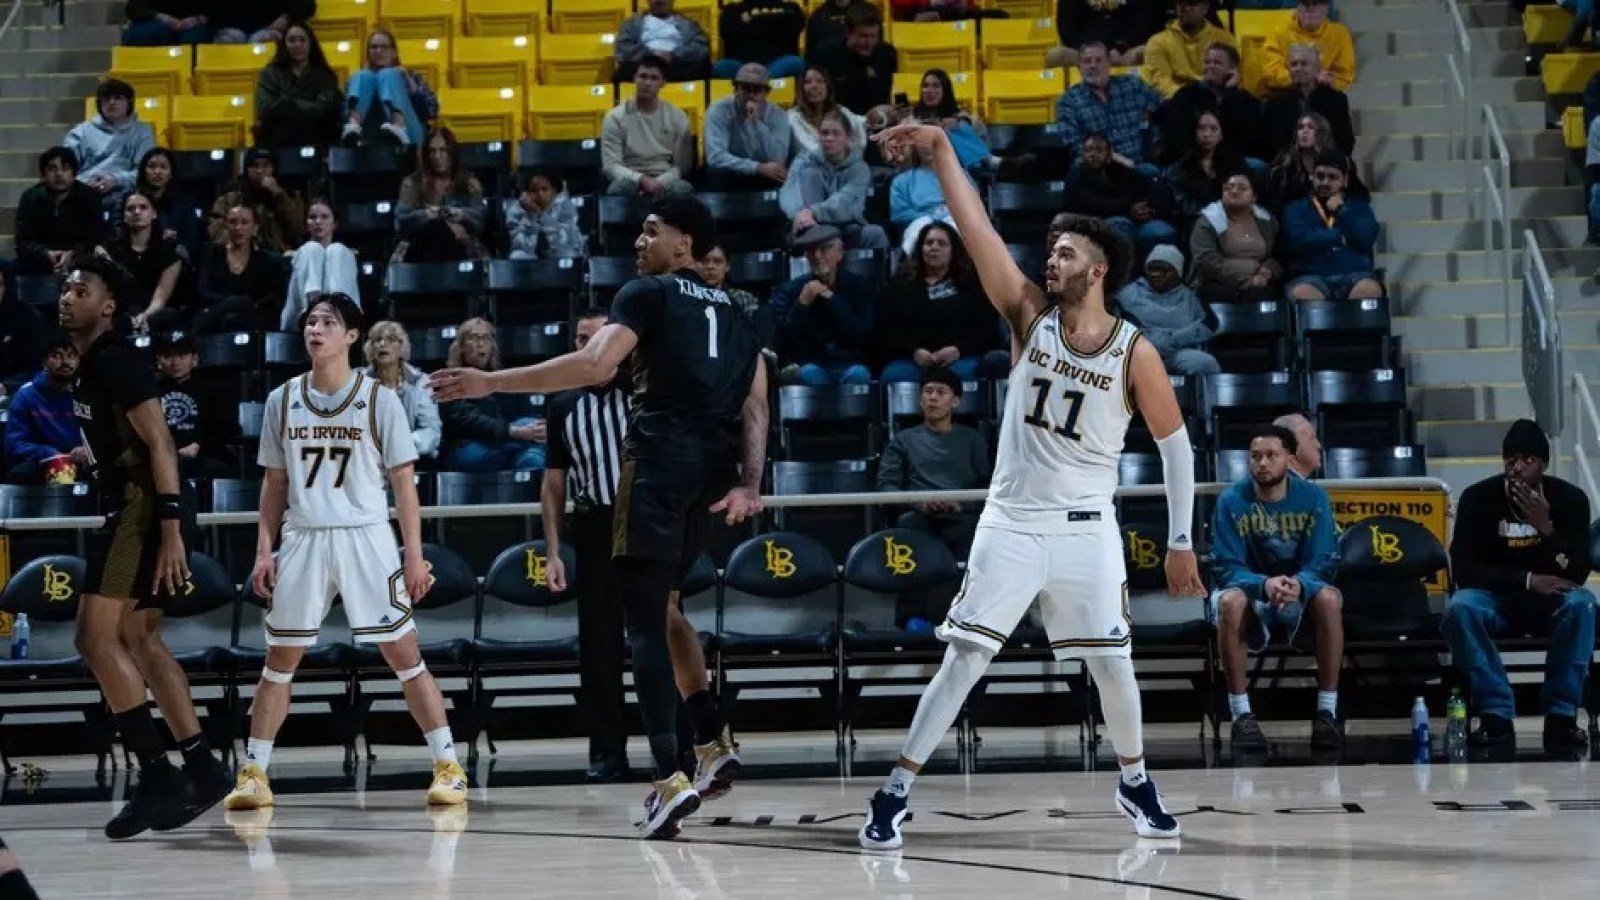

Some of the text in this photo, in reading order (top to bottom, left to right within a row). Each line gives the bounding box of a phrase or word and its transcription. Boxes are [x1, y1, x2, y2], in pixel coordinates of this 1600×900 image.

[704, 305, 718, 358] 1
[1028, 347, 1114, 392] UC IRVINE
[1023, 377, 1085, 442] 11
[288, 425, 363, 440] UC IRVINE
[300, 446, 352, 489] 77
[1405, 502, 1433, 516] 110
